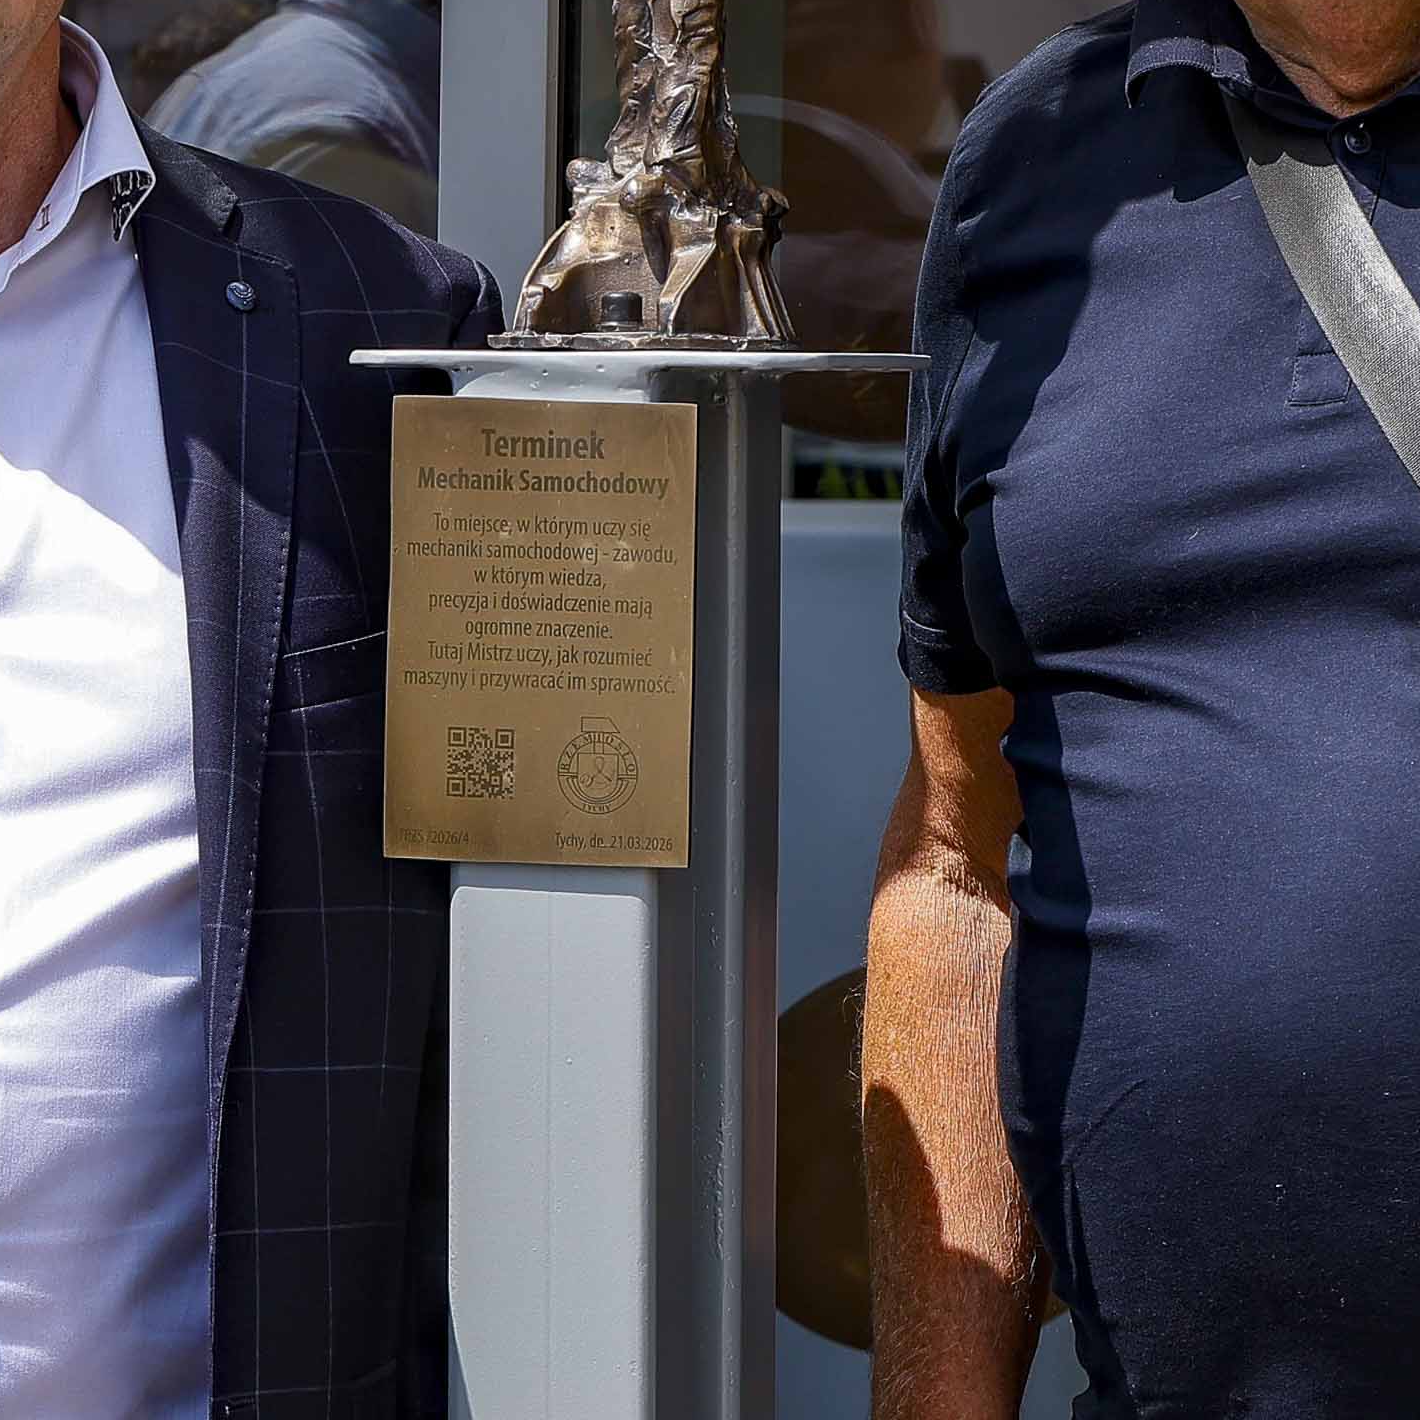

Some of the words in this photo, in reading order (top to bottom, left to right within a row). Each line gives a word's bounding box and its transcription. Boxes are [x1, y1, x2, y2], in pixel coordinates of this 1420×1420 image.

[481, 429, 605, 459] Terminek
[417, 467, 515, 492] Mechanik
[518, 469, 669, 499] Samochodowy
[433, 513, 450, 531] To
[454, 514, 513, 534] miejsce,
[516, 520, 530, 532] w
[534, 516, 588, 539] którym
[592, 521, 626, 540] uczy
[630, 520, 651, 541] się
[407, 539, 483, 558] mechaniki
[486, 542, 599, 565] samochodowej
[613, 545, 678, 565] zawodu,
[474, 570, 488, 583] w
[491, 566, 545, 589] którym
[549, 568, 607, 590] wiedza,
[428, 592, 489, 613] precyzja
[492, 592, 498, 609] i
[501, 592, 611, 613] doświadczenie
[615, 599, 653, 620] mają
[465, 622, 532, 640] ogromne
[535, 622, 613, 640] znaczenie.
[428, 640, 464, 664] Tutaj
[467, 642, 512, 662] Mistrz
[516, 647, 553, 667] uczy,
[555, 645, 579, 667] jak
[583, 647, 653, 667] rozumieć
[404, 669, 469, 689] maszyny
[479, 671, 565, 692] przywracać
[567, 672, 587, 689] im
[590, 674, 676, 696] sprawność.
[556, 831, 587, 851] Tychy,
[610, 834, 673, 851] 21.03.2026
